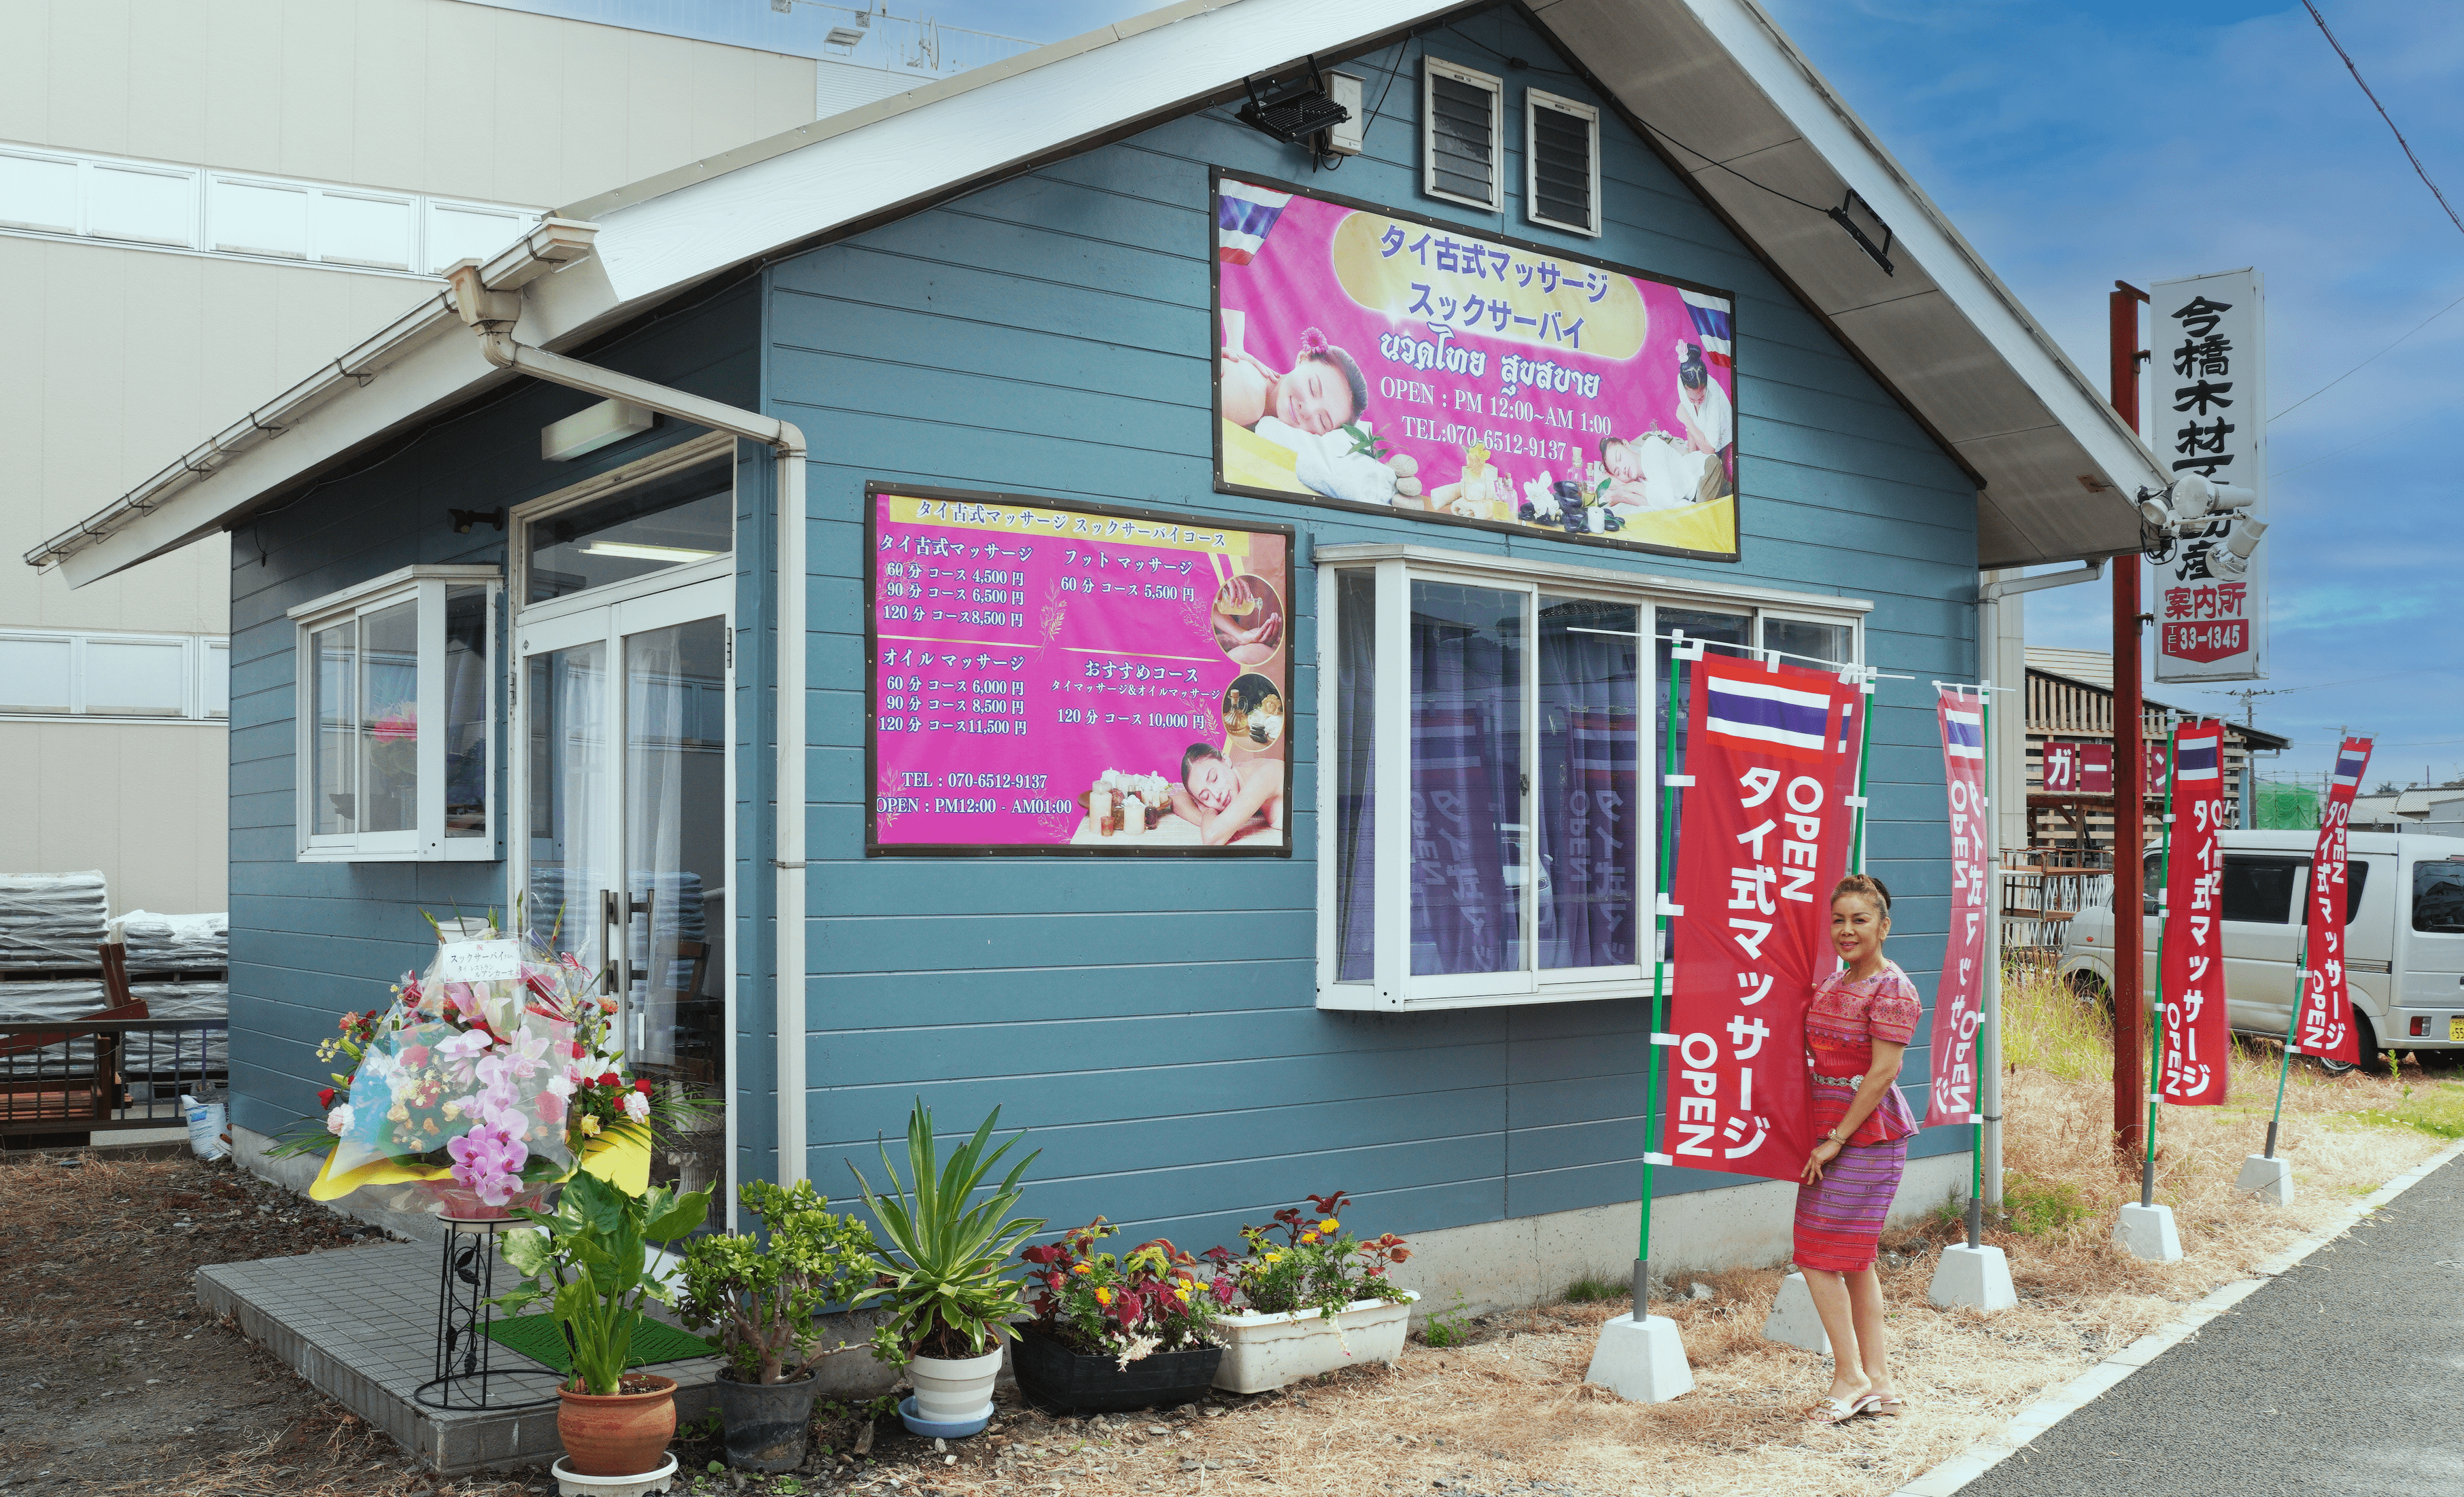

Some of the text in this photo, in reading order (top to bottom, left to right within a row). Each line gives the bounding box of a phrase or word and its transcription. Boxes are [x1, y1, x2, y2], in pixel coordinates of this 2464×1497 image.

[1379, 224, 1608, 303] タイ古式マッサージ
[1408, 281, 1585, 349] スックサーバイ
[1378, 321, 1601, 400] นวดไทย สุขสบาย
[1380, 376, 1435, 406] OPEN
[1454, 389, 1483, 414] PM
[1580, 412, 1612, 436] 1:00
[1401, 415, 1567, 461] TEL:070-6512-9137
[917, 500, 1069, 529] タイ古式マッサージ
[880, 534, 1033, 562] タイ古式マッサージ
[1065, 549, 1194, 576] フット マッサージ
[2164, 582, 2246, 620] 案内所
[882, 648, 1026, 671] オイル マッサージ
[1084, 658, 1198, 683] おすすめコース
[2168, 624, 2240, 653] TEL 33-1345
[876, 797, 920, 813] OPEN
[934, 797, 997, 814] PM12:00
[1010, 798, 1073, 815] AM01:00
[901, 771, 934, 788] TEL
[947, 772, 1048, 789] 070-6512-9137
[1780, 775, 1824, 903] OPEN
[2331, 803, 2348, 884] OPEN
[2182, 800, 2213, 1097] タイ式マッサージ
[2317, 800, 2346, 1050] タイ式マッサージ
[1723, 767, 1781, 1159] タイ式マッサージ
[2303, 969, 2326, 1049] OPEN
[2166, 1002, 2182, 1097] OPEN
[1676, 1032, 1718, 1158] OPEN
